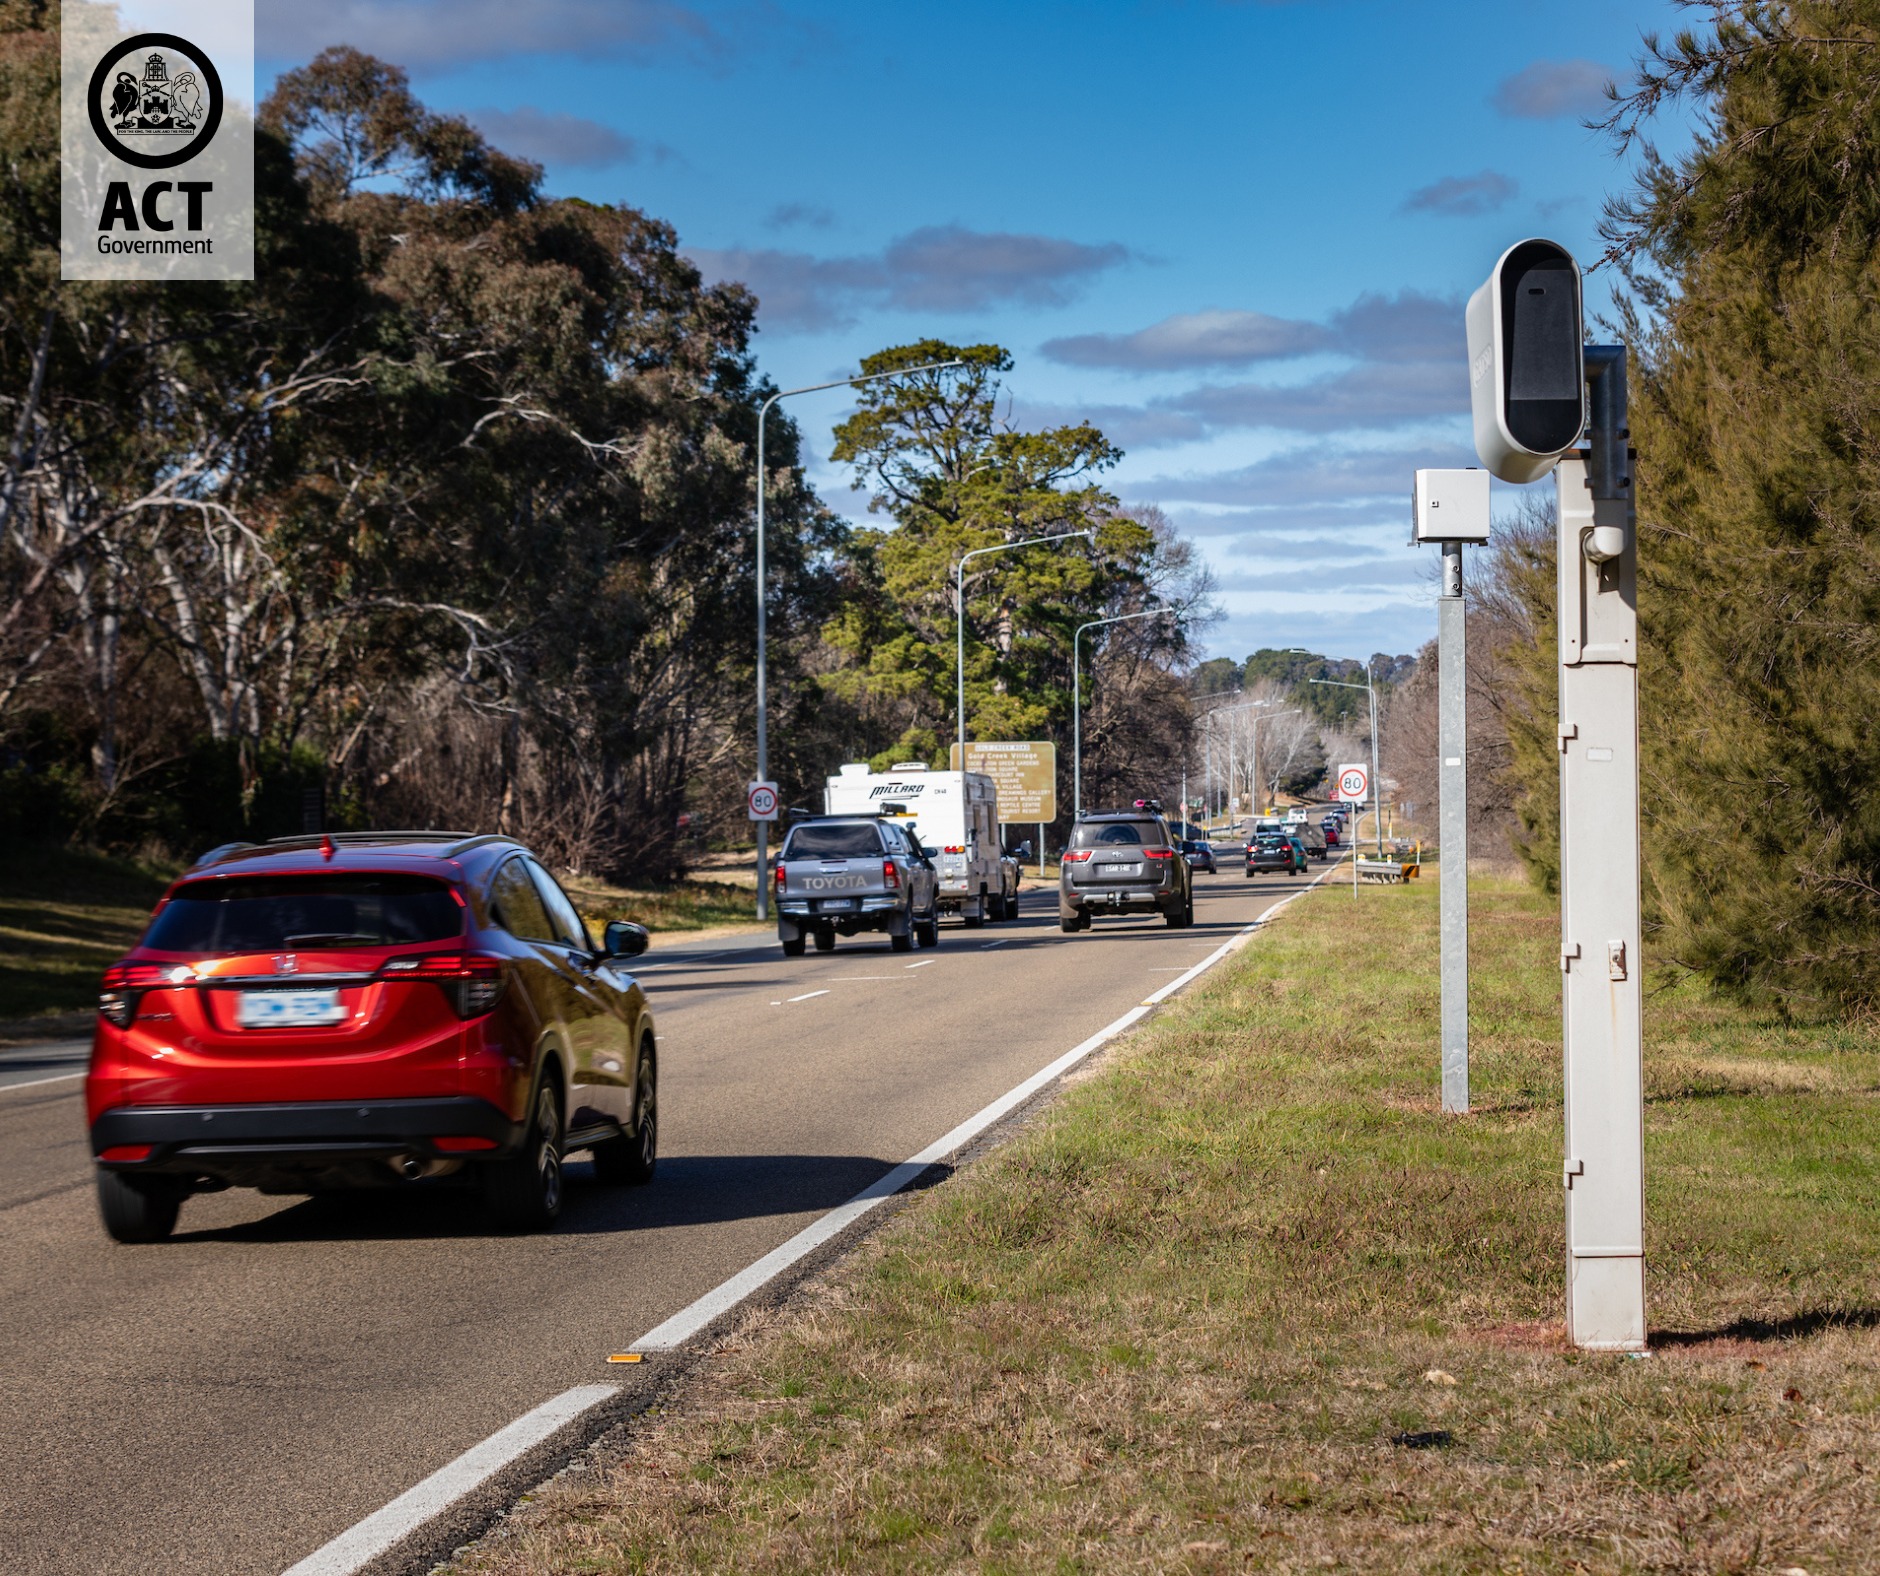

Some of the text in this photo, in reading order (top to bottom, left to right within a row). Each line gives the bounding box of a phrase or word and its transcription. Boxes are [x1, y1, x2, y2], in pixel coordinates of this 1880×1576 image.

[1344, 778, 1361, 789] 80
[869, 784, 924, 799] MILLARD
[755, 796, 771, 807] 80
[802, 875, 867, 890] TOYOTA
